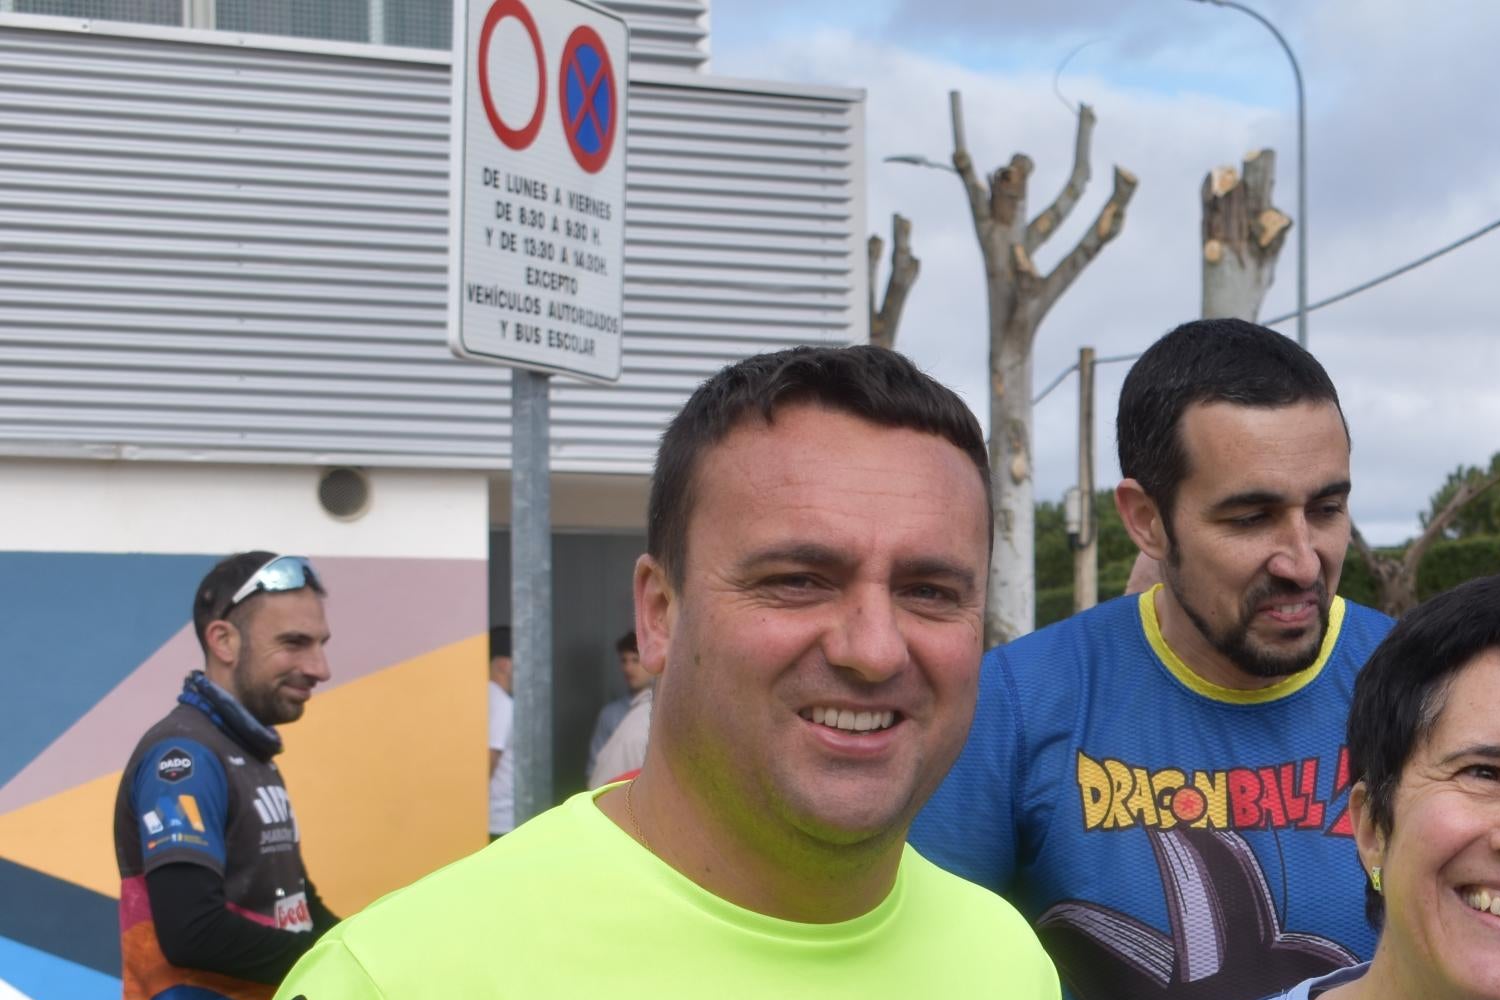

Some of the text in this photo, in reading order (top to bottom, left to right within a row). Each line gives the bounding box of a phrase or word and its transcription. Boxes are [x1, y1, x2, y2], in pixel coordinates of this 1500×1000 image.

[483, 167, 612, 220] DE LUNES A VIERNES
[496, 201, 512, 222] DE
[552, 216, 559, 232] A
[486, 228, 493, 246] Y
[501, 232, 516, 252] DE
[561, 247, 568, 264] A
[526, 266, 578, 295] EXCEPTO
[468, 284, 618, 334] VEHÍCULOS AUTORIZADOS
[500, 320, 596, 356] Y BUS ESCOLAR
[1076, 749, 1227, 832] DRAGON
[1227, 757, 1326, 830] BALL
